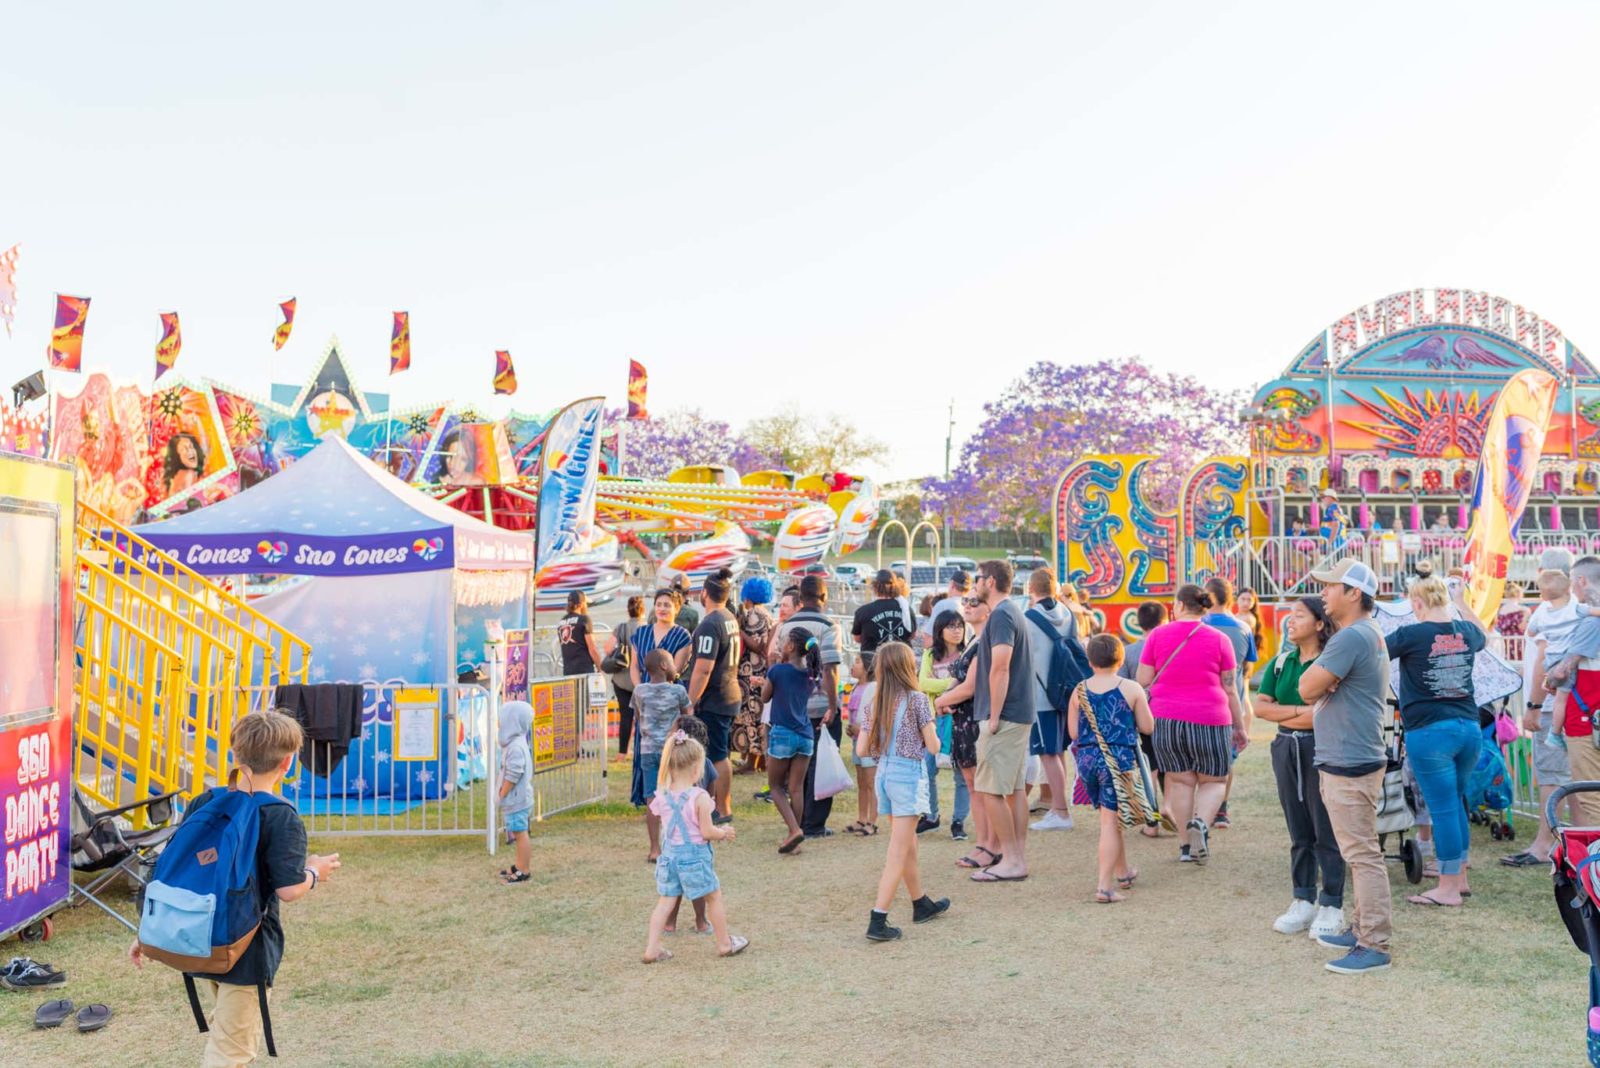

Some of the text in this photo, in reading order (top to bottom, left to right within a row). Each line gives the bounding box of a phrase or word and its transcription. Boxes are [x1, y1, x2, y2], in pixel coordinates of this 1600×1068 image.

[1331, 287, 1566, 371] AVALANCHE
[187, 544, 252, 564] Cones
[294, 544, 409, 566] Sno Cones
[697, 635, 713, 654] 10
[17, 732, 50, 785] 360
[5, 781, 60, 843] DANCE
[5, 830, 59, 898] PARTY
